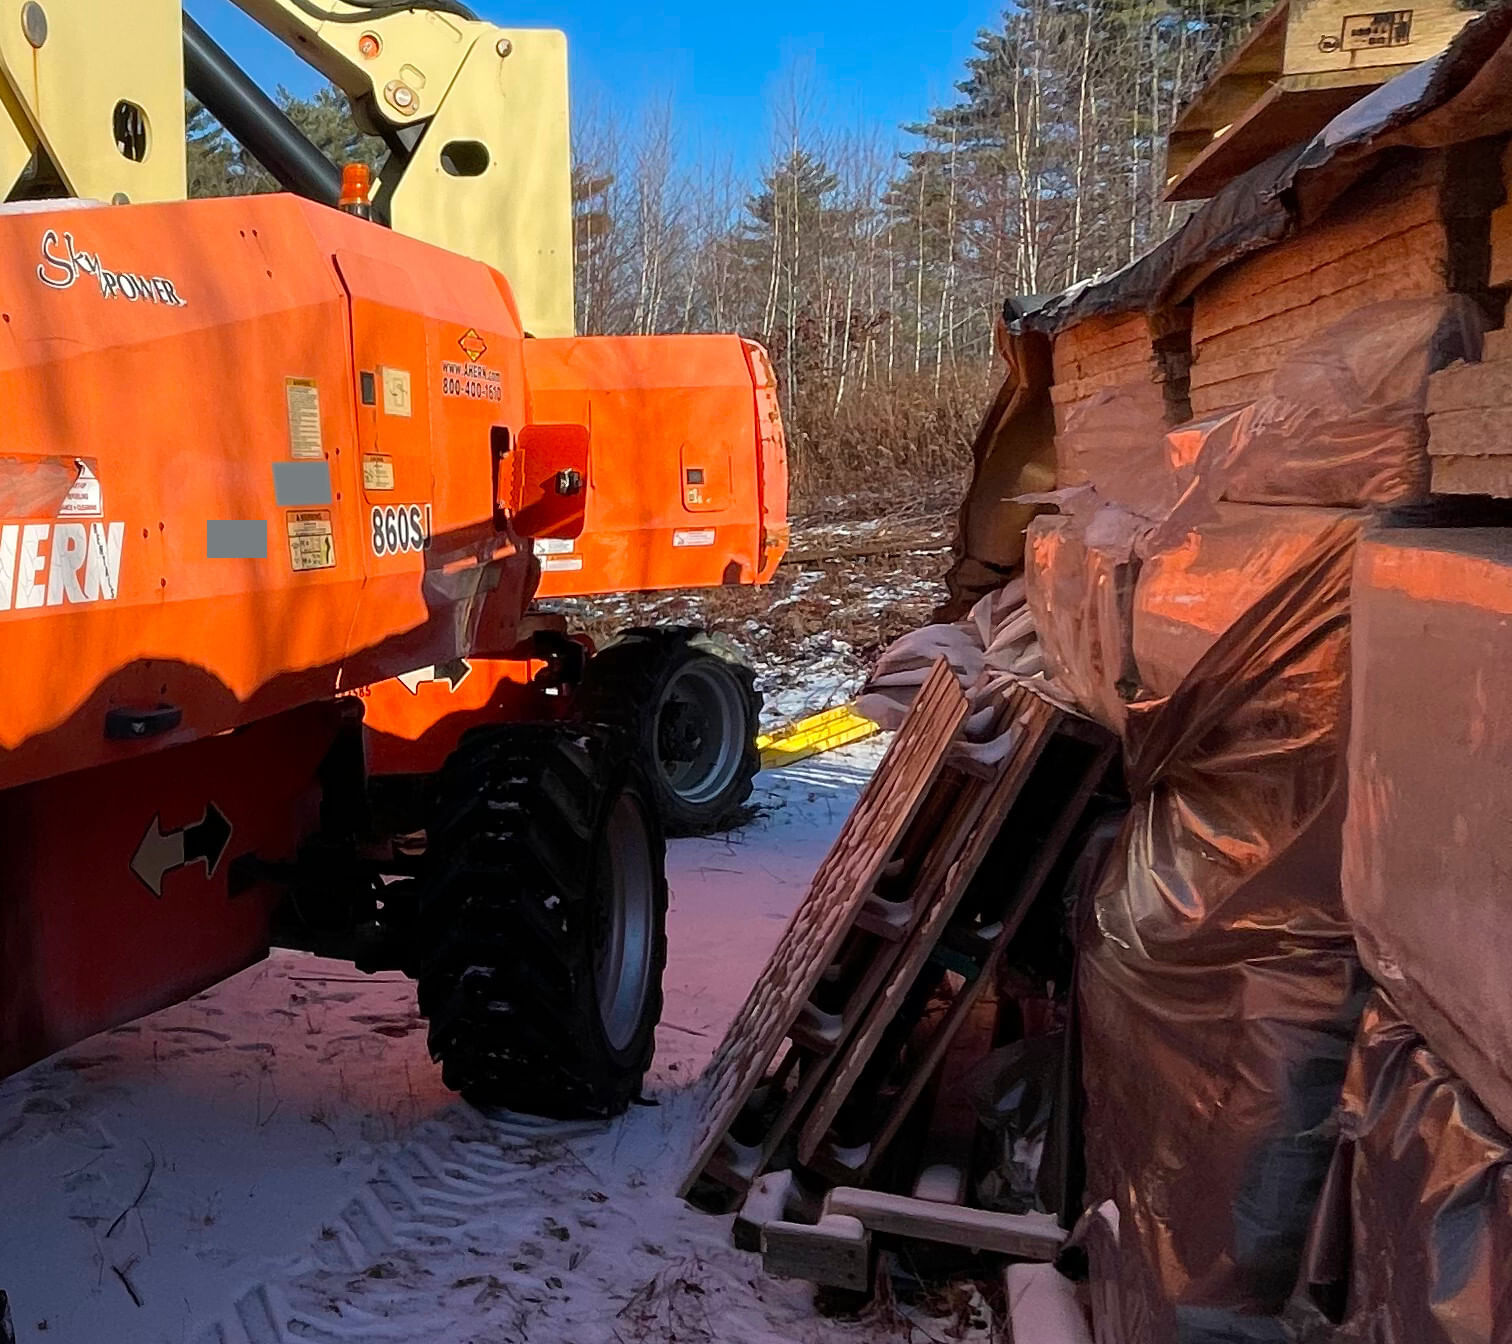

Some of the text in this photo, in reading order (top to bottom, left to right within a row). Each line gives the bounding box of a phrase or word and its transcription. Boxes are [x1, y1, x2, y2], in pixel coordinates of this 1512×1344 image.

[100, 269, 187, 307] POWER
[442, 377, 502, 402] 800-400-1610
[371, 504, 433, 557] 860SJ
